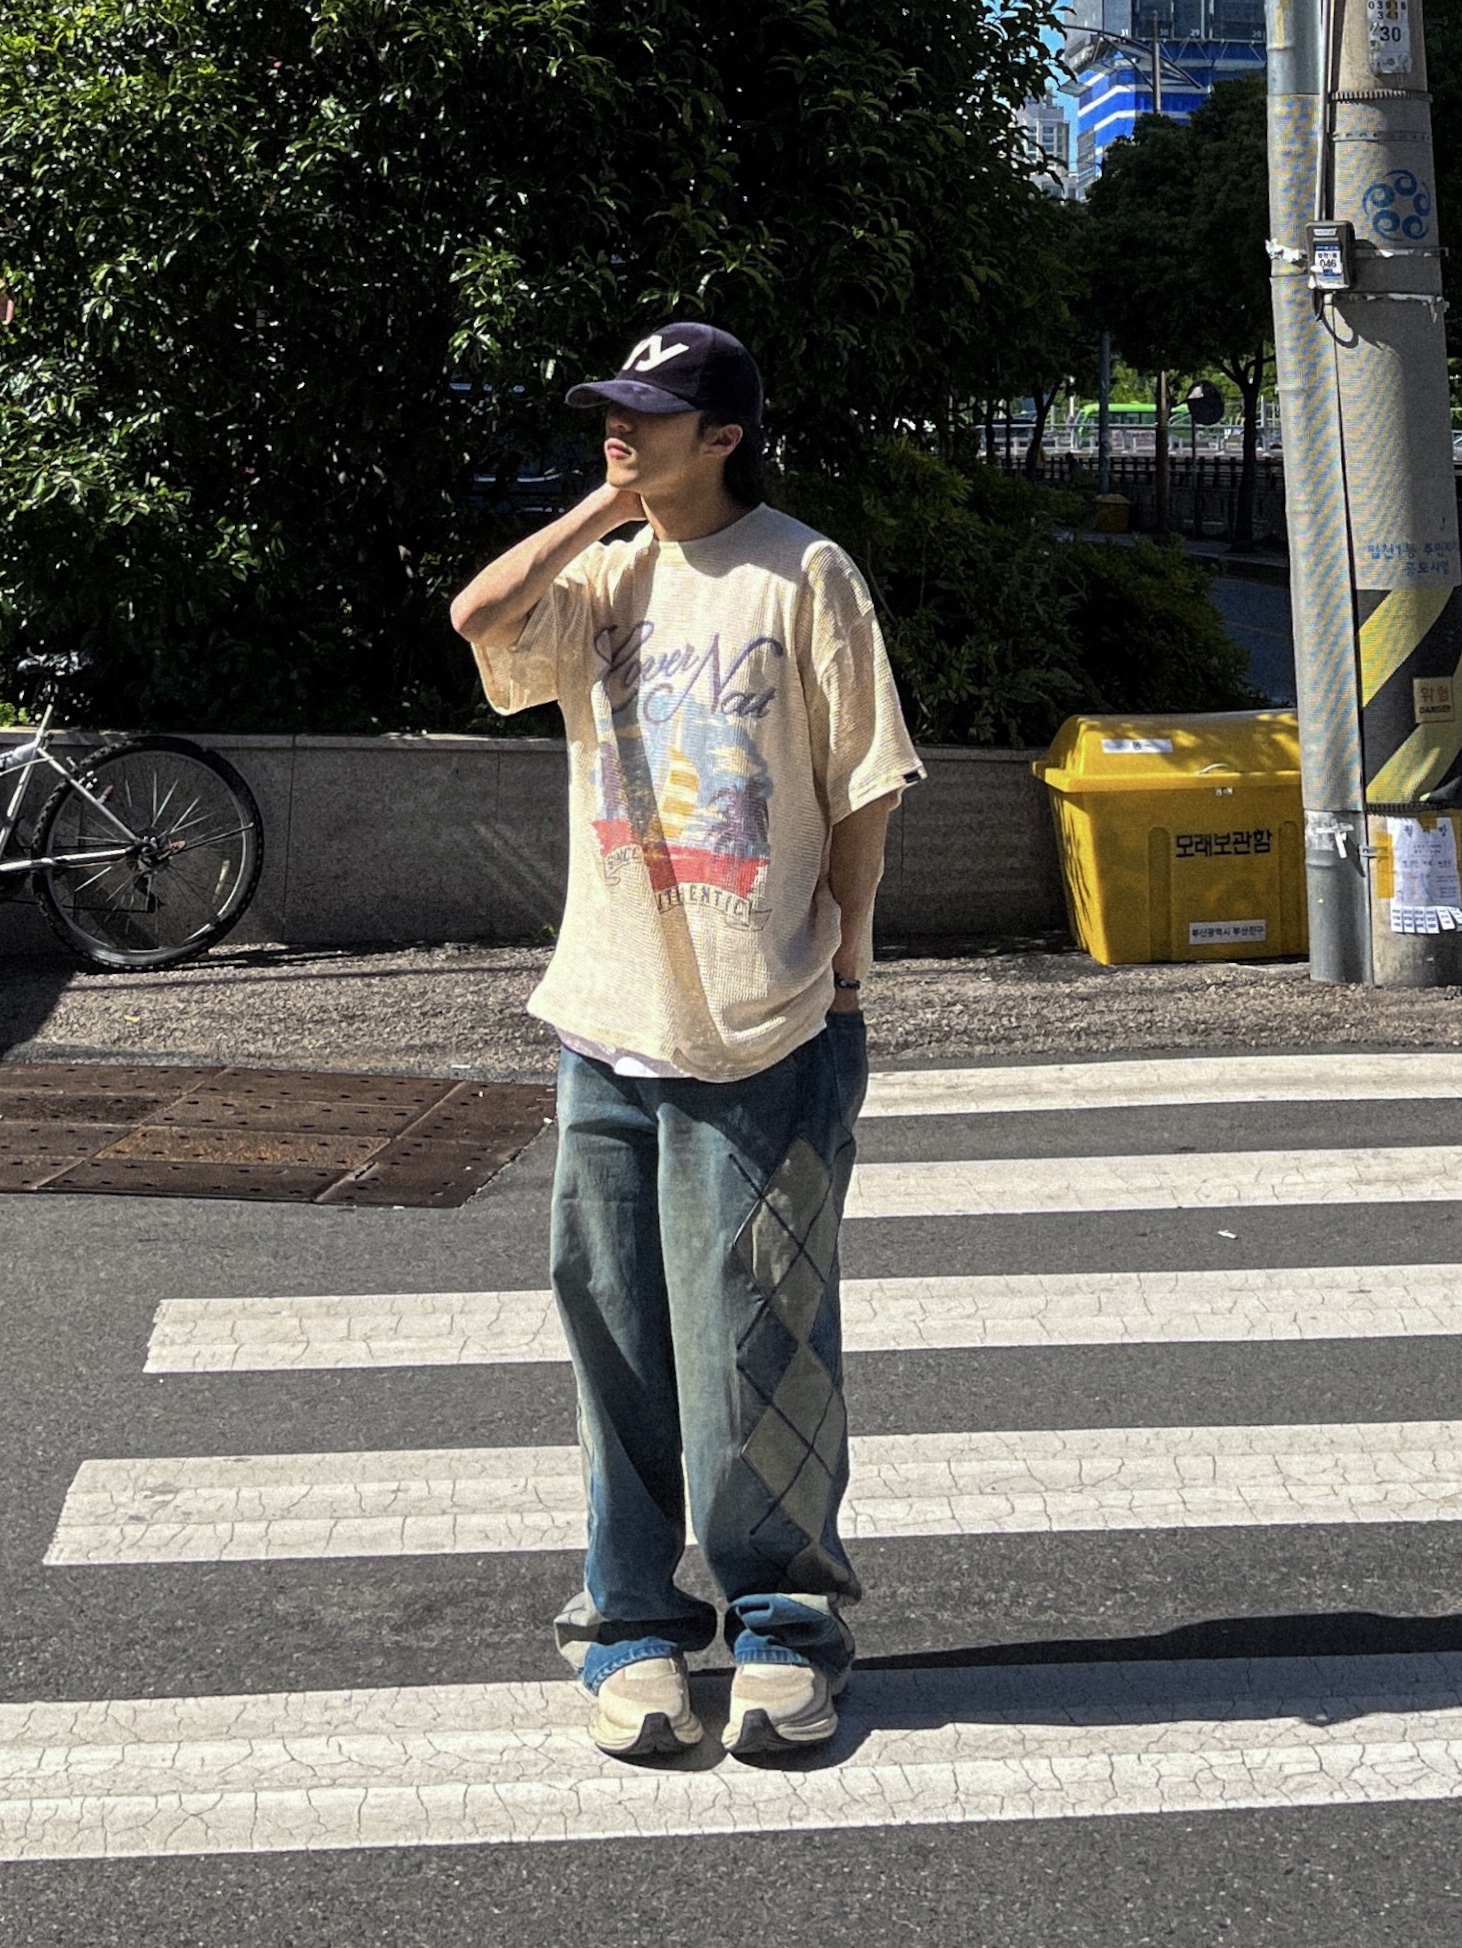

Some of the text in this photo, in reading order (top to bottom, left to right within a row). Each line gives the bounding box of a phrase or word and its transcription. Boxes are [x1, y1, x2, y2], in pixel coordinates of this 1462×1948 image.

[1379, 26, 1402, 42] 30
[1420, 686, 1449, 703] 위험
[1419, 704, 1451, 714] DANGER
[1175, 829, 1273, 859] 모래보관함
